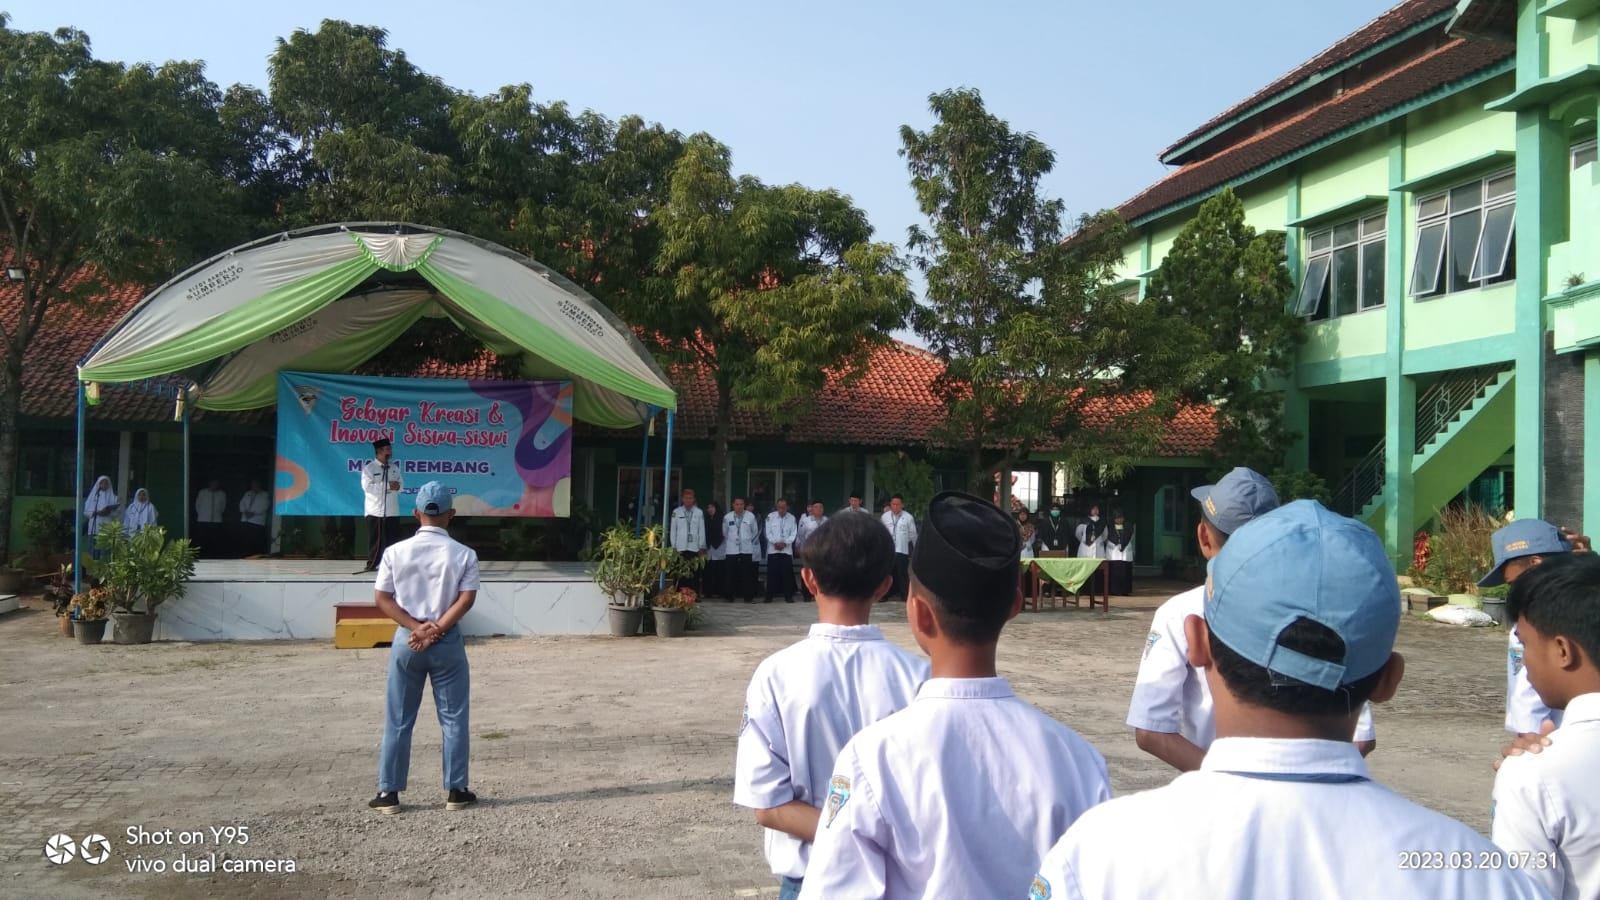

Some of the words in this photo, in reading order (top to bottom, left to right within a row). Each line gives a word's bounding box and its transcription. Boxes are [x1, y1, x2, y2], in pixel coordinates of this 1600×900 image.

[340, 397, 410, 424] Gebyar
[419, 400, 480, 424] Kreasi
[488, 401, 504, 424] &
[330, 420, 394, 444] Inovasi
[404, 421, 508, 446] Siswa-siswi
[405, 460, 489, 474] REMBANG
